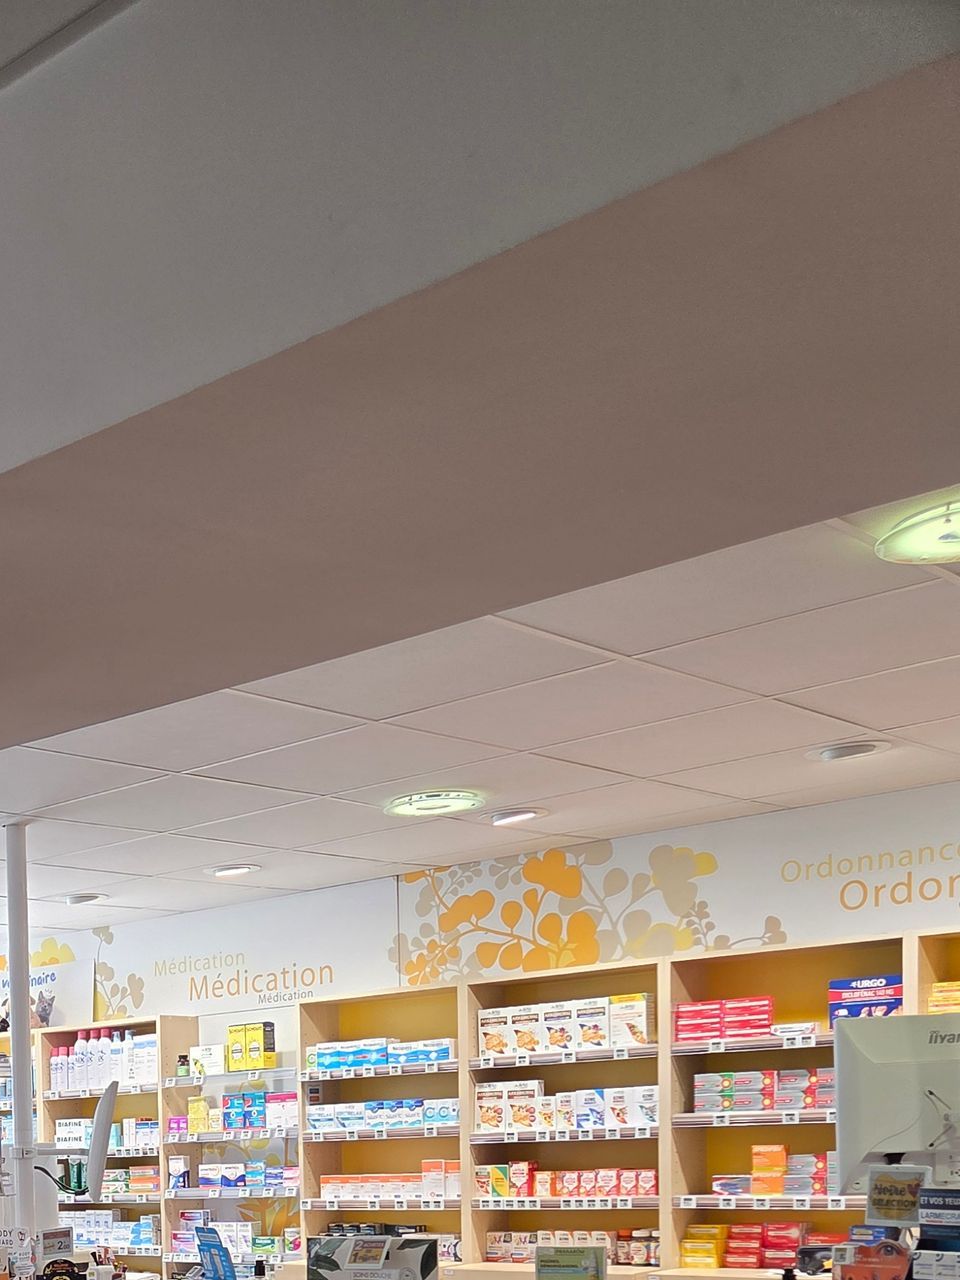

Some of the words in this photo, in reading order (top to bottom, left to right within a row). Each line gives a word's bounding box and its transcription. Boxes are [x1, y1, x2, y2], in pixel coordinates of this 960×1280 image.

[154, 952, 245, 977] Médication
[189, 962, 334, 1001] Médication
[857, 979, 886, 988] URGO
[258, 989, 314, 1005] Médication
